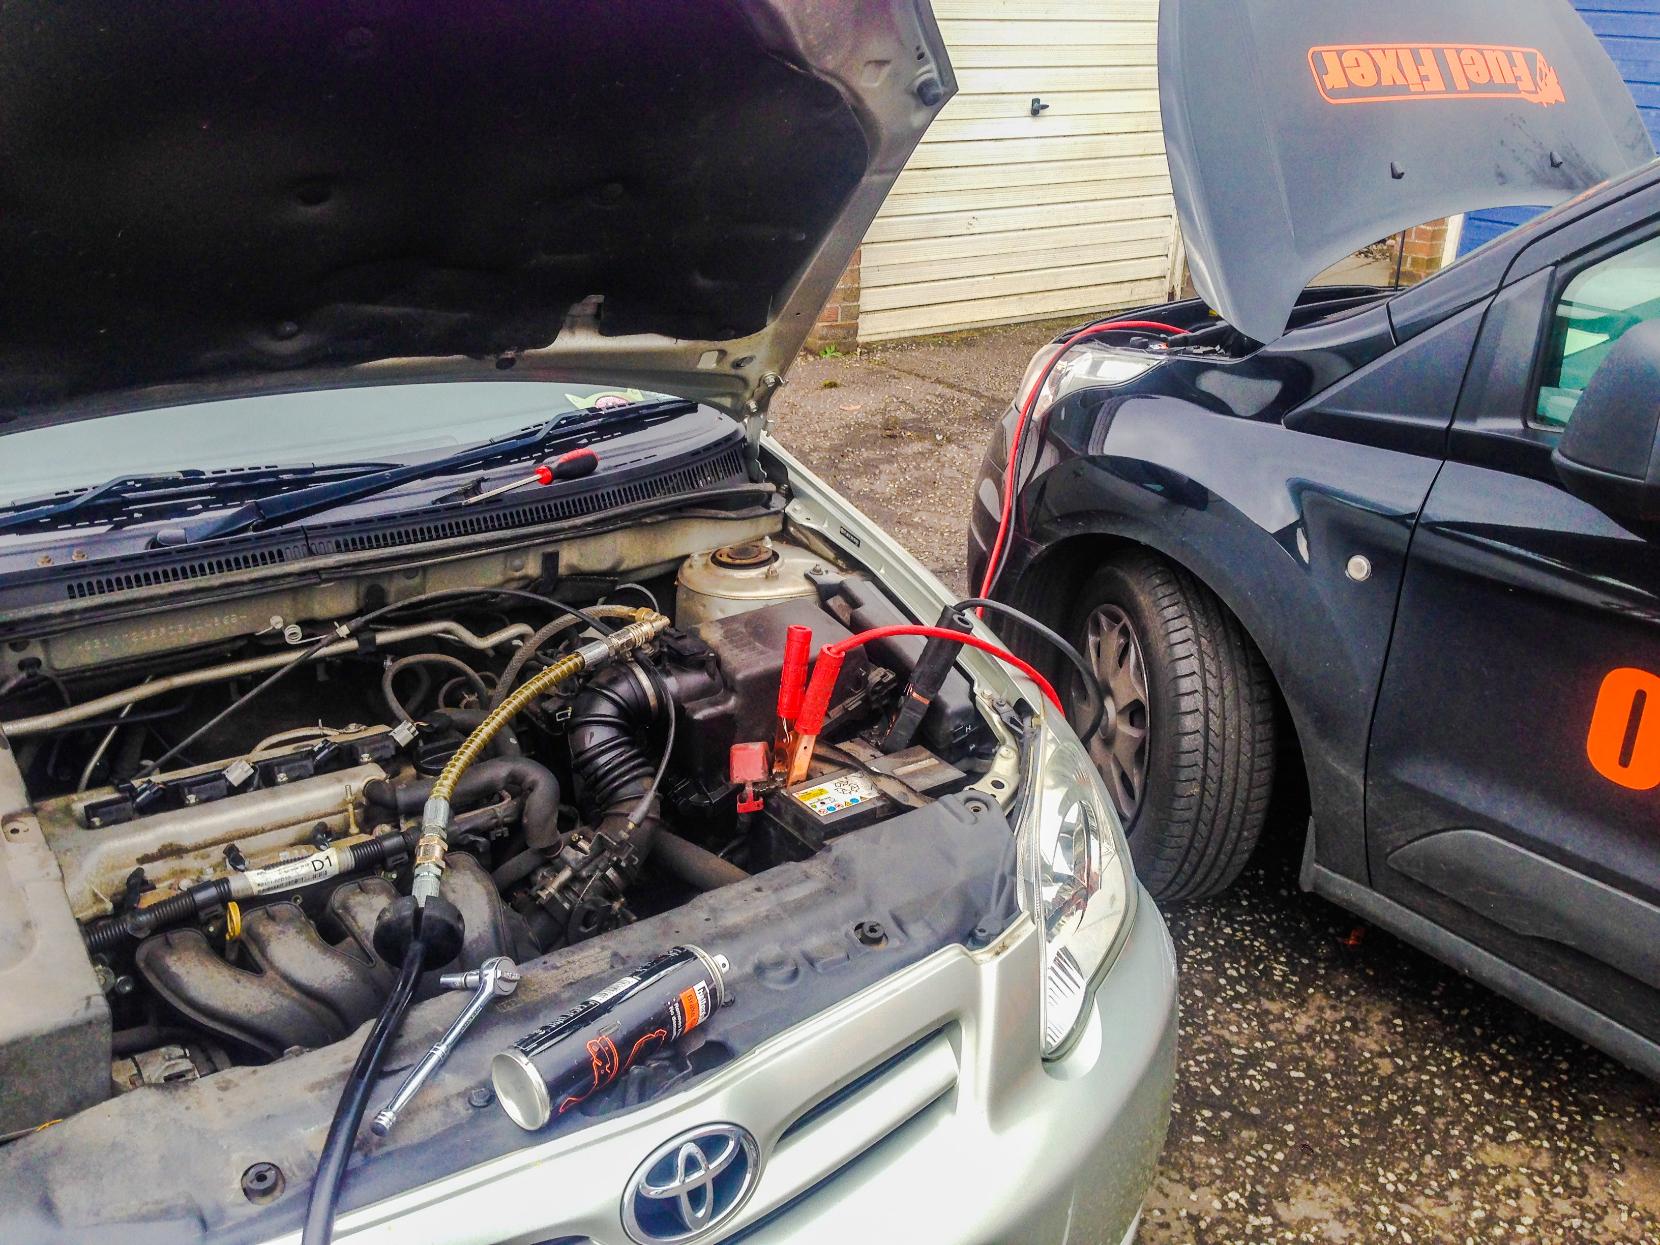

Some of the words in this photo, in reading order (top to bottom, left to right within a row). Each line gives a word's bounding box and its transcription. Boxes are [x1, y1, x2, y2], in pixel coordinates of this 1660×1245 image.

[1321, 48, 1446, 93] Fixer
[1444, 48, 1539, 94] Fuel
[311, 855, 332, 872] D1
